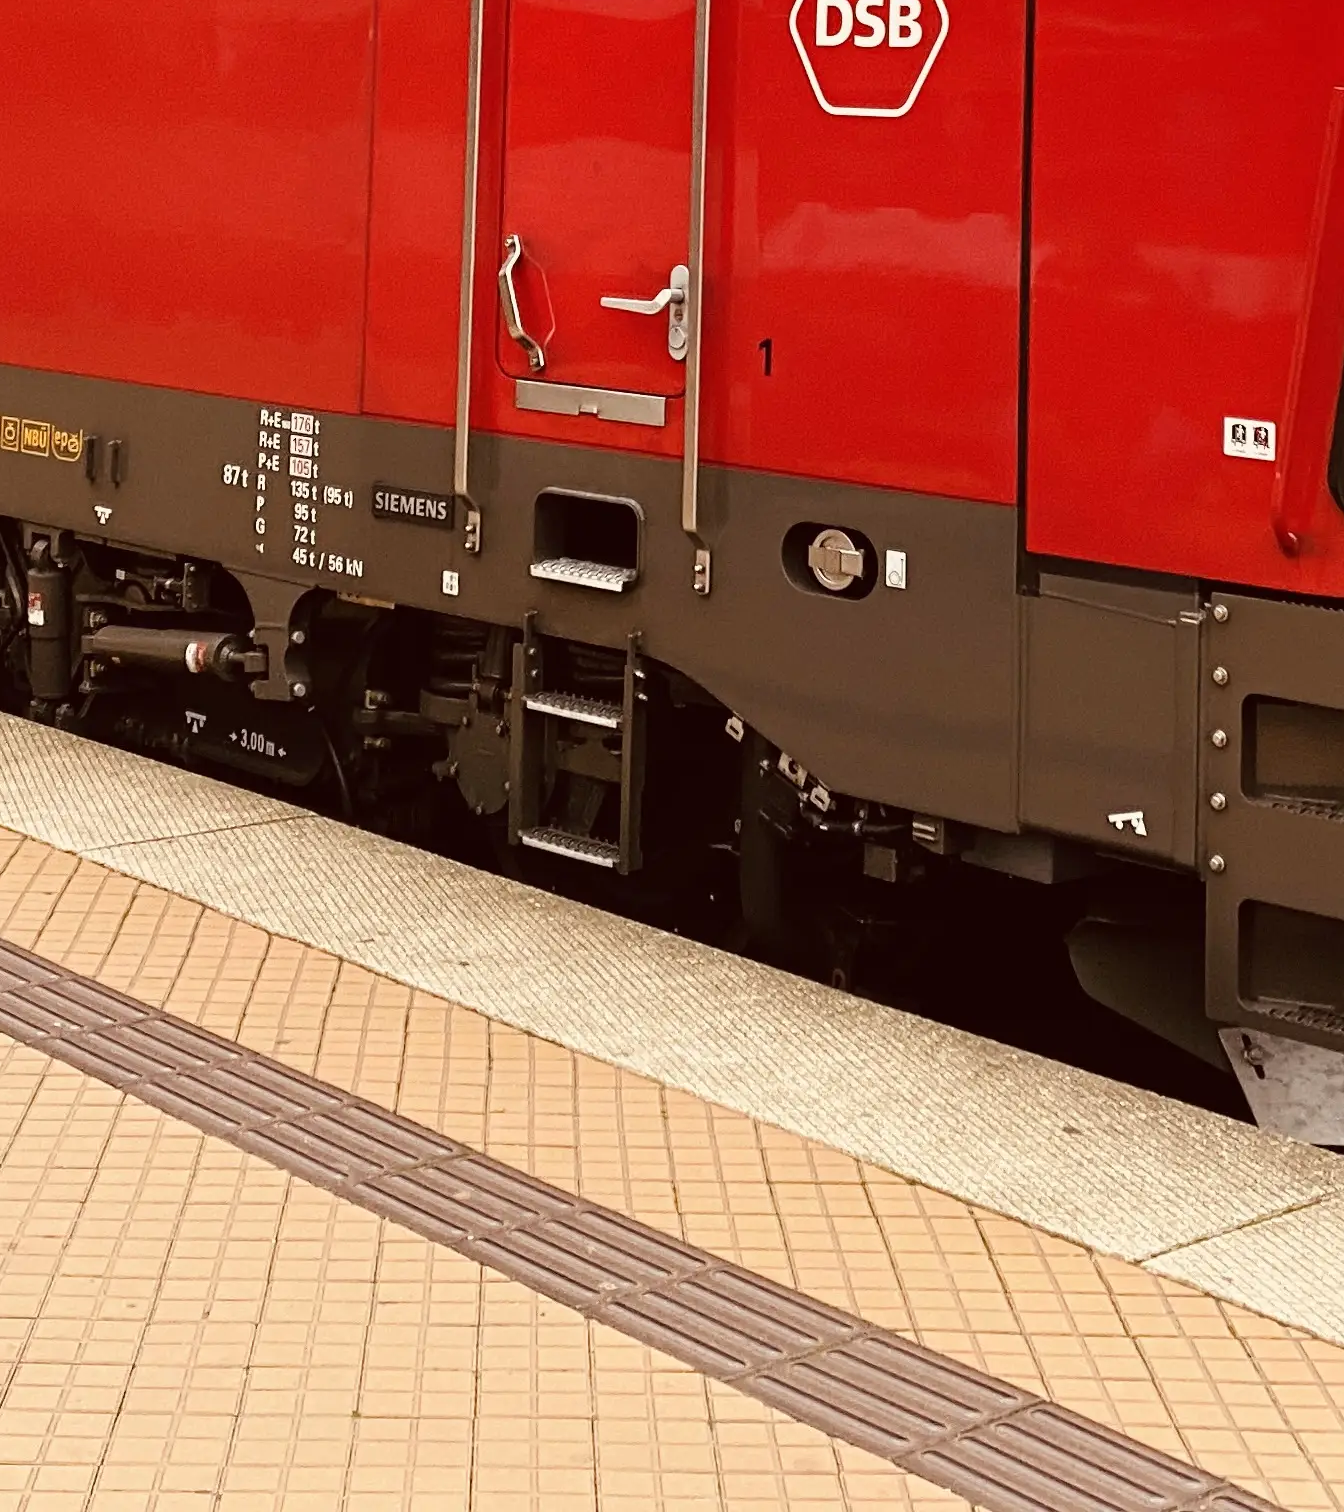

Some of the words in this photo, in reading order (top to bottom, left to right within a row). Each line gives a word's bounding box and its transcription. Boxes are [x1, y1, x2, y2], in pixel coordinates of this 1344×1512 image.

[758, 338, 772, 377] 1
[293, 416, 311, 433] 176
[314, 419, 321, 435] t
[258, 430, 281, 450] R+E
[292, 437, 310, 455] 157
[313, 441, 320, 457] t
[258, 452, 280, 472] P+E
[312, 463, 319, 479] t
[290, 480, 310, 499] 135
[311, 485, 318, 501] t
[256, 495, 265, 512] P
[294, 503, 309, 521] 95
[310, 507, 317, 523] t
[375, 491, 448, 520] SIEMENS
[255, 517, 266, 535] G
[293, 524, 309, 543] 72
[309, 530, 316, 545] t
[292, 547, 308, 565] 45
[308, 551, 316, 568] t
[328, 554, 344, 573] 56
[345, 557, 364, 578] kN
